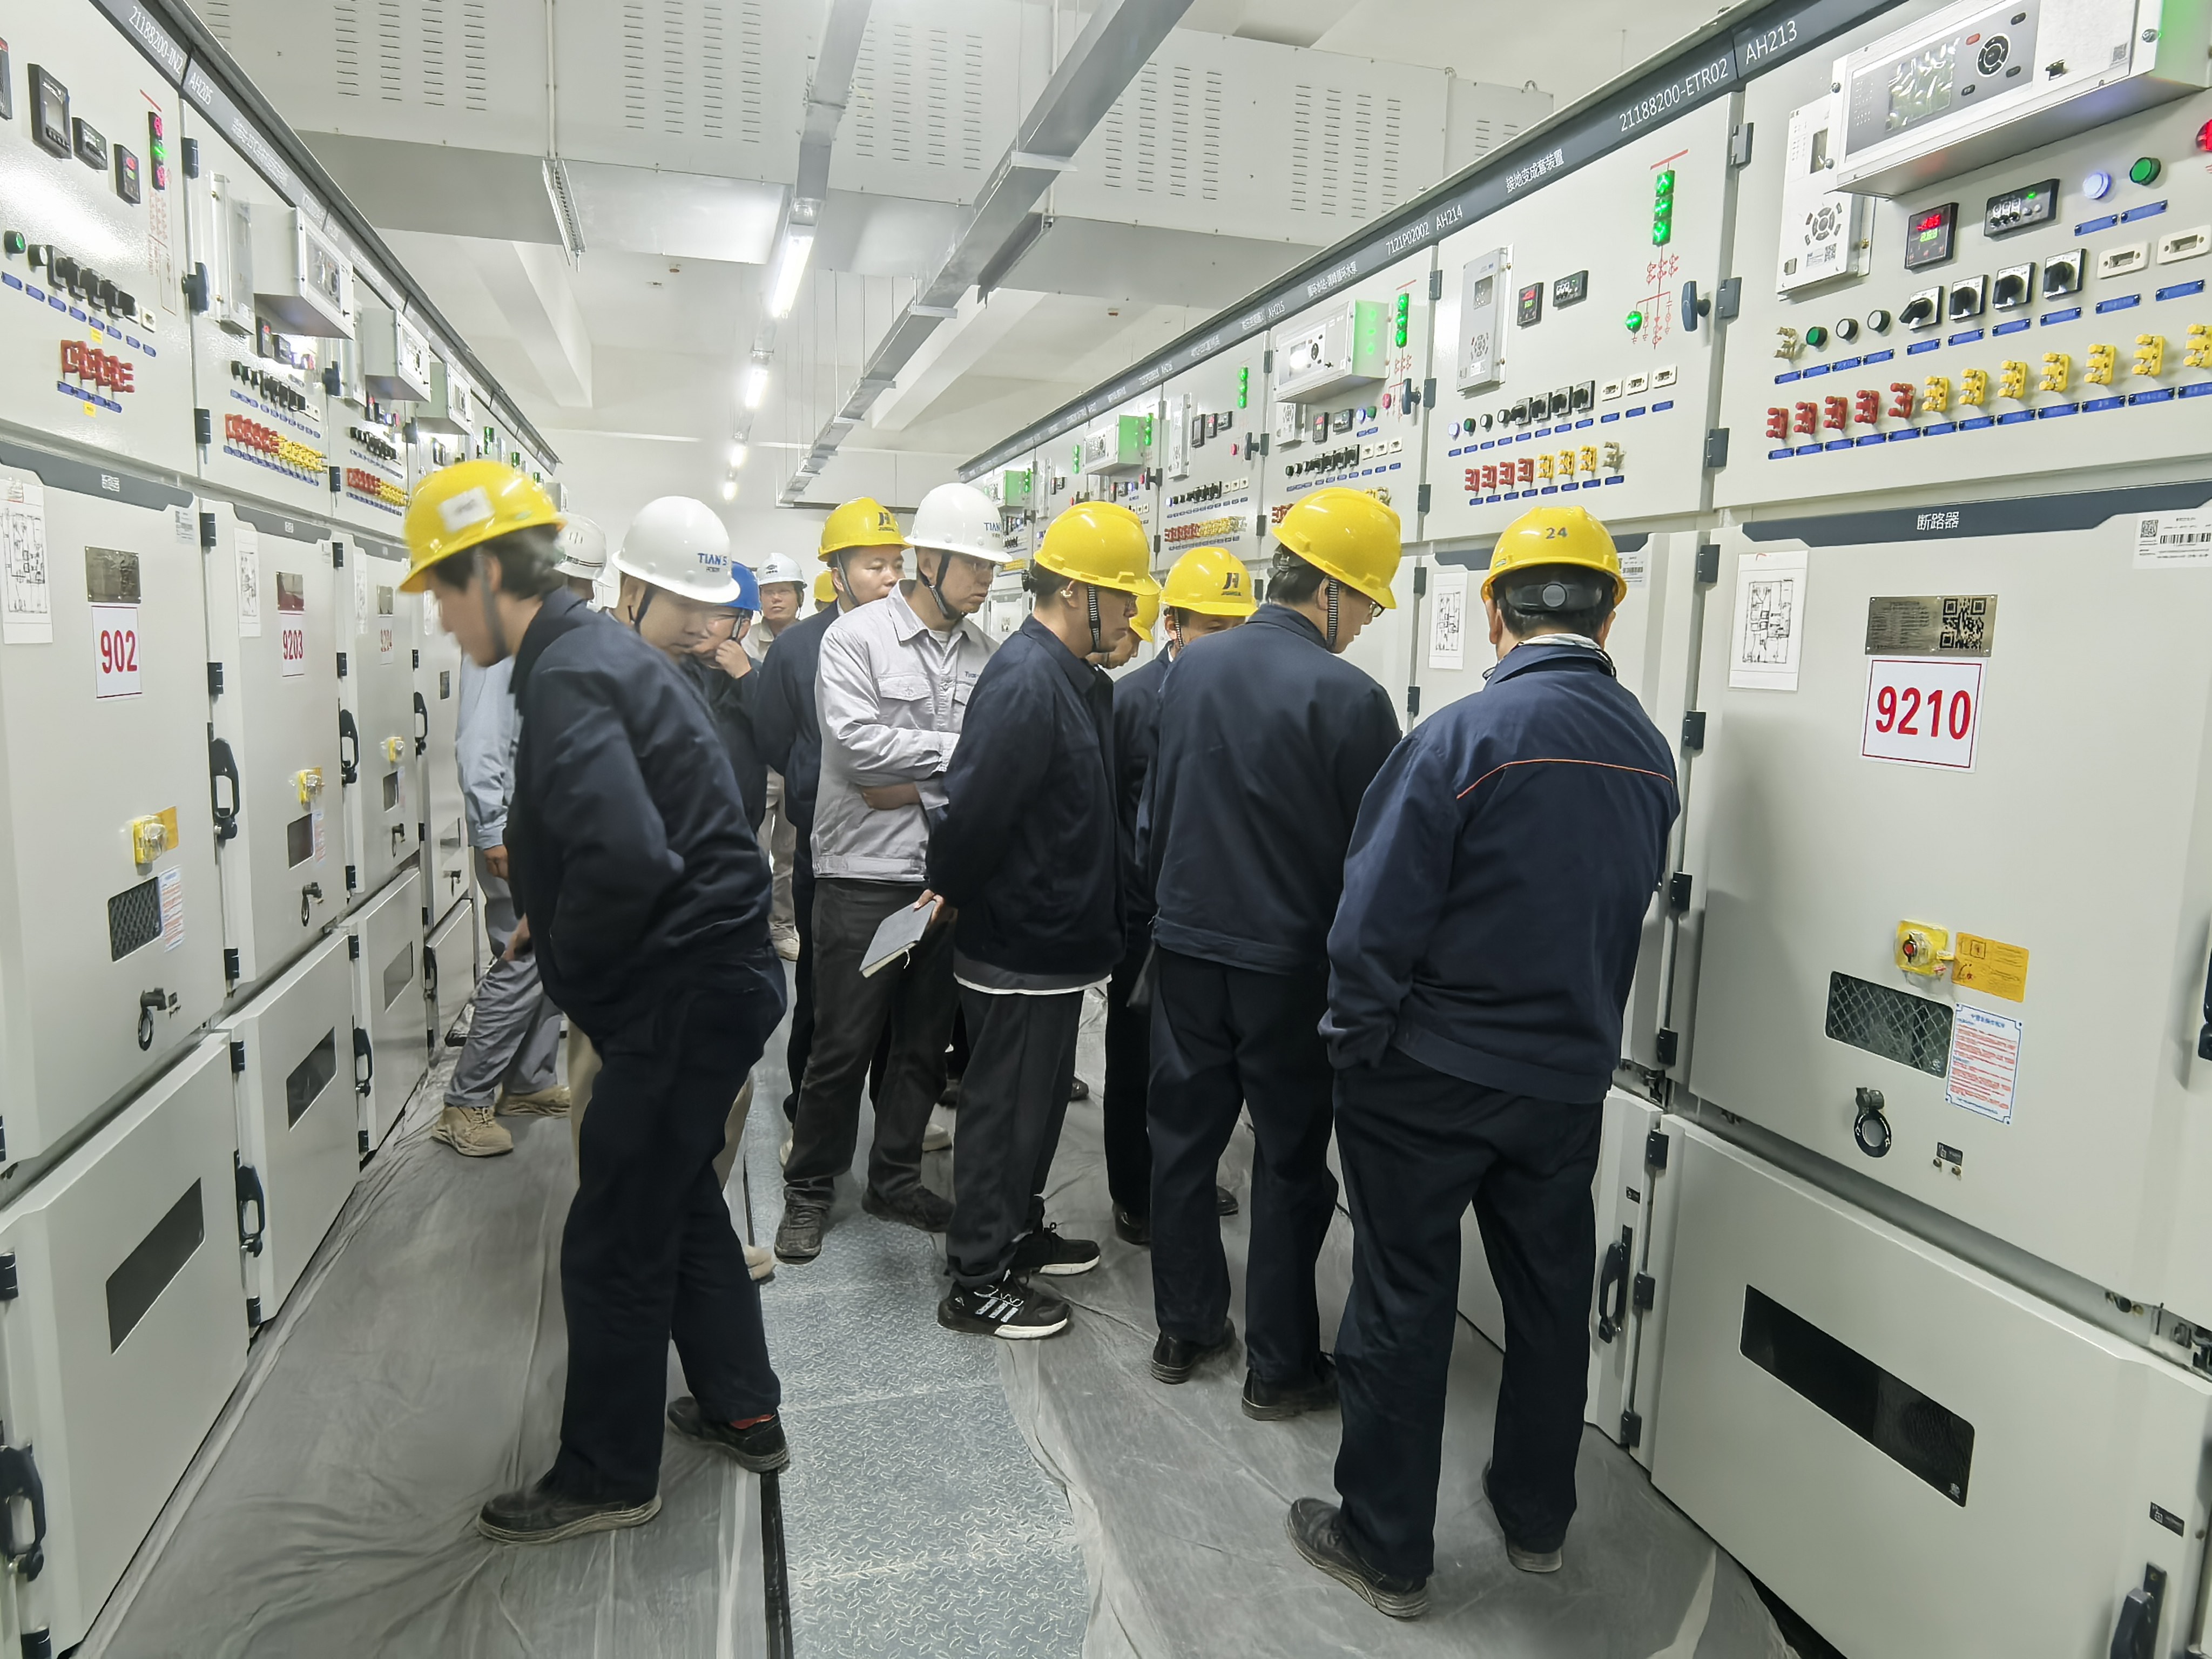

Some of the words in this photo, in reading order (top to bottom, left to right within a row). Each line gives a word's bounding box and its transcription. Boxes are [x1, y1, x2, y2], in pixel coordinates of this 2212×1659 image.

[1745, 20, 1798, 65] AH213
[1619, 58, 1729, 132] 21188200-ETR02
[1435, 204, 1464, 231] AH214
[1545, 527, 1568, 539] 24
[1916, 511, 1960, 531] 断路器
[100, 630, 138, 674] 902
[282, 629, 304, 660] 9203
[1875, 685, 1972, 740] 9210
